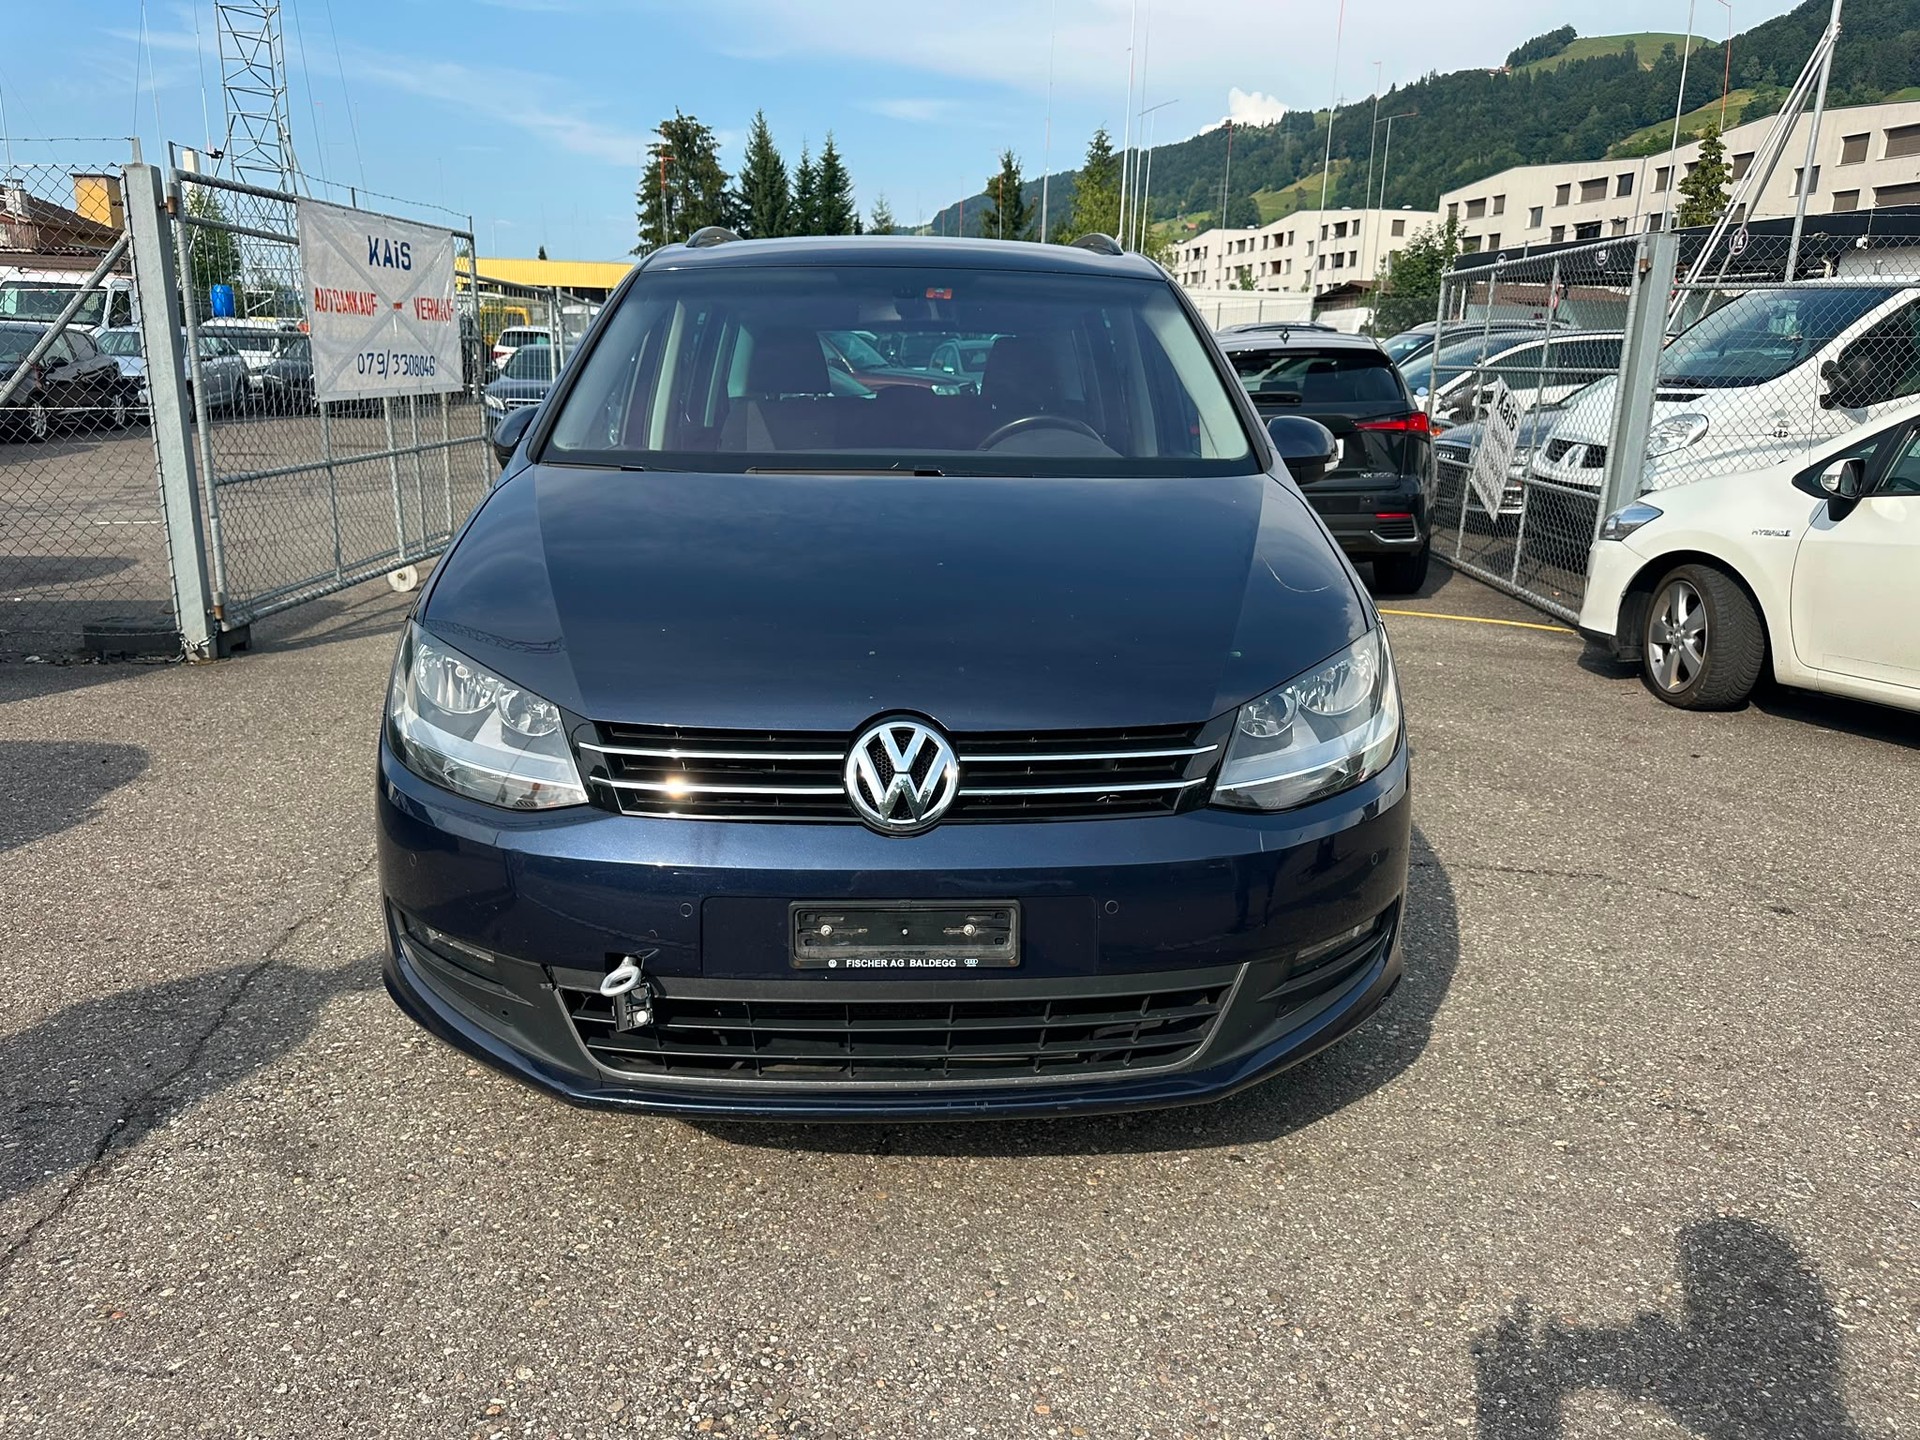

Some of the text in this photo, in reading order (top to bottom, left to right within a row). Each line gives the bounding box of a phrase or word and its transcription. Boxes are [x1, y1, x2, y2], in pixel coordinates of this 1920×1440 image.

[314, 287, 378, 317] AUTOANKAUF
[357, 350, 436, 380] 079/3308046
[1496, 388, 1518, 432] Kais
[846, 959, 957, 968] FISCHER AG BALDEGG
